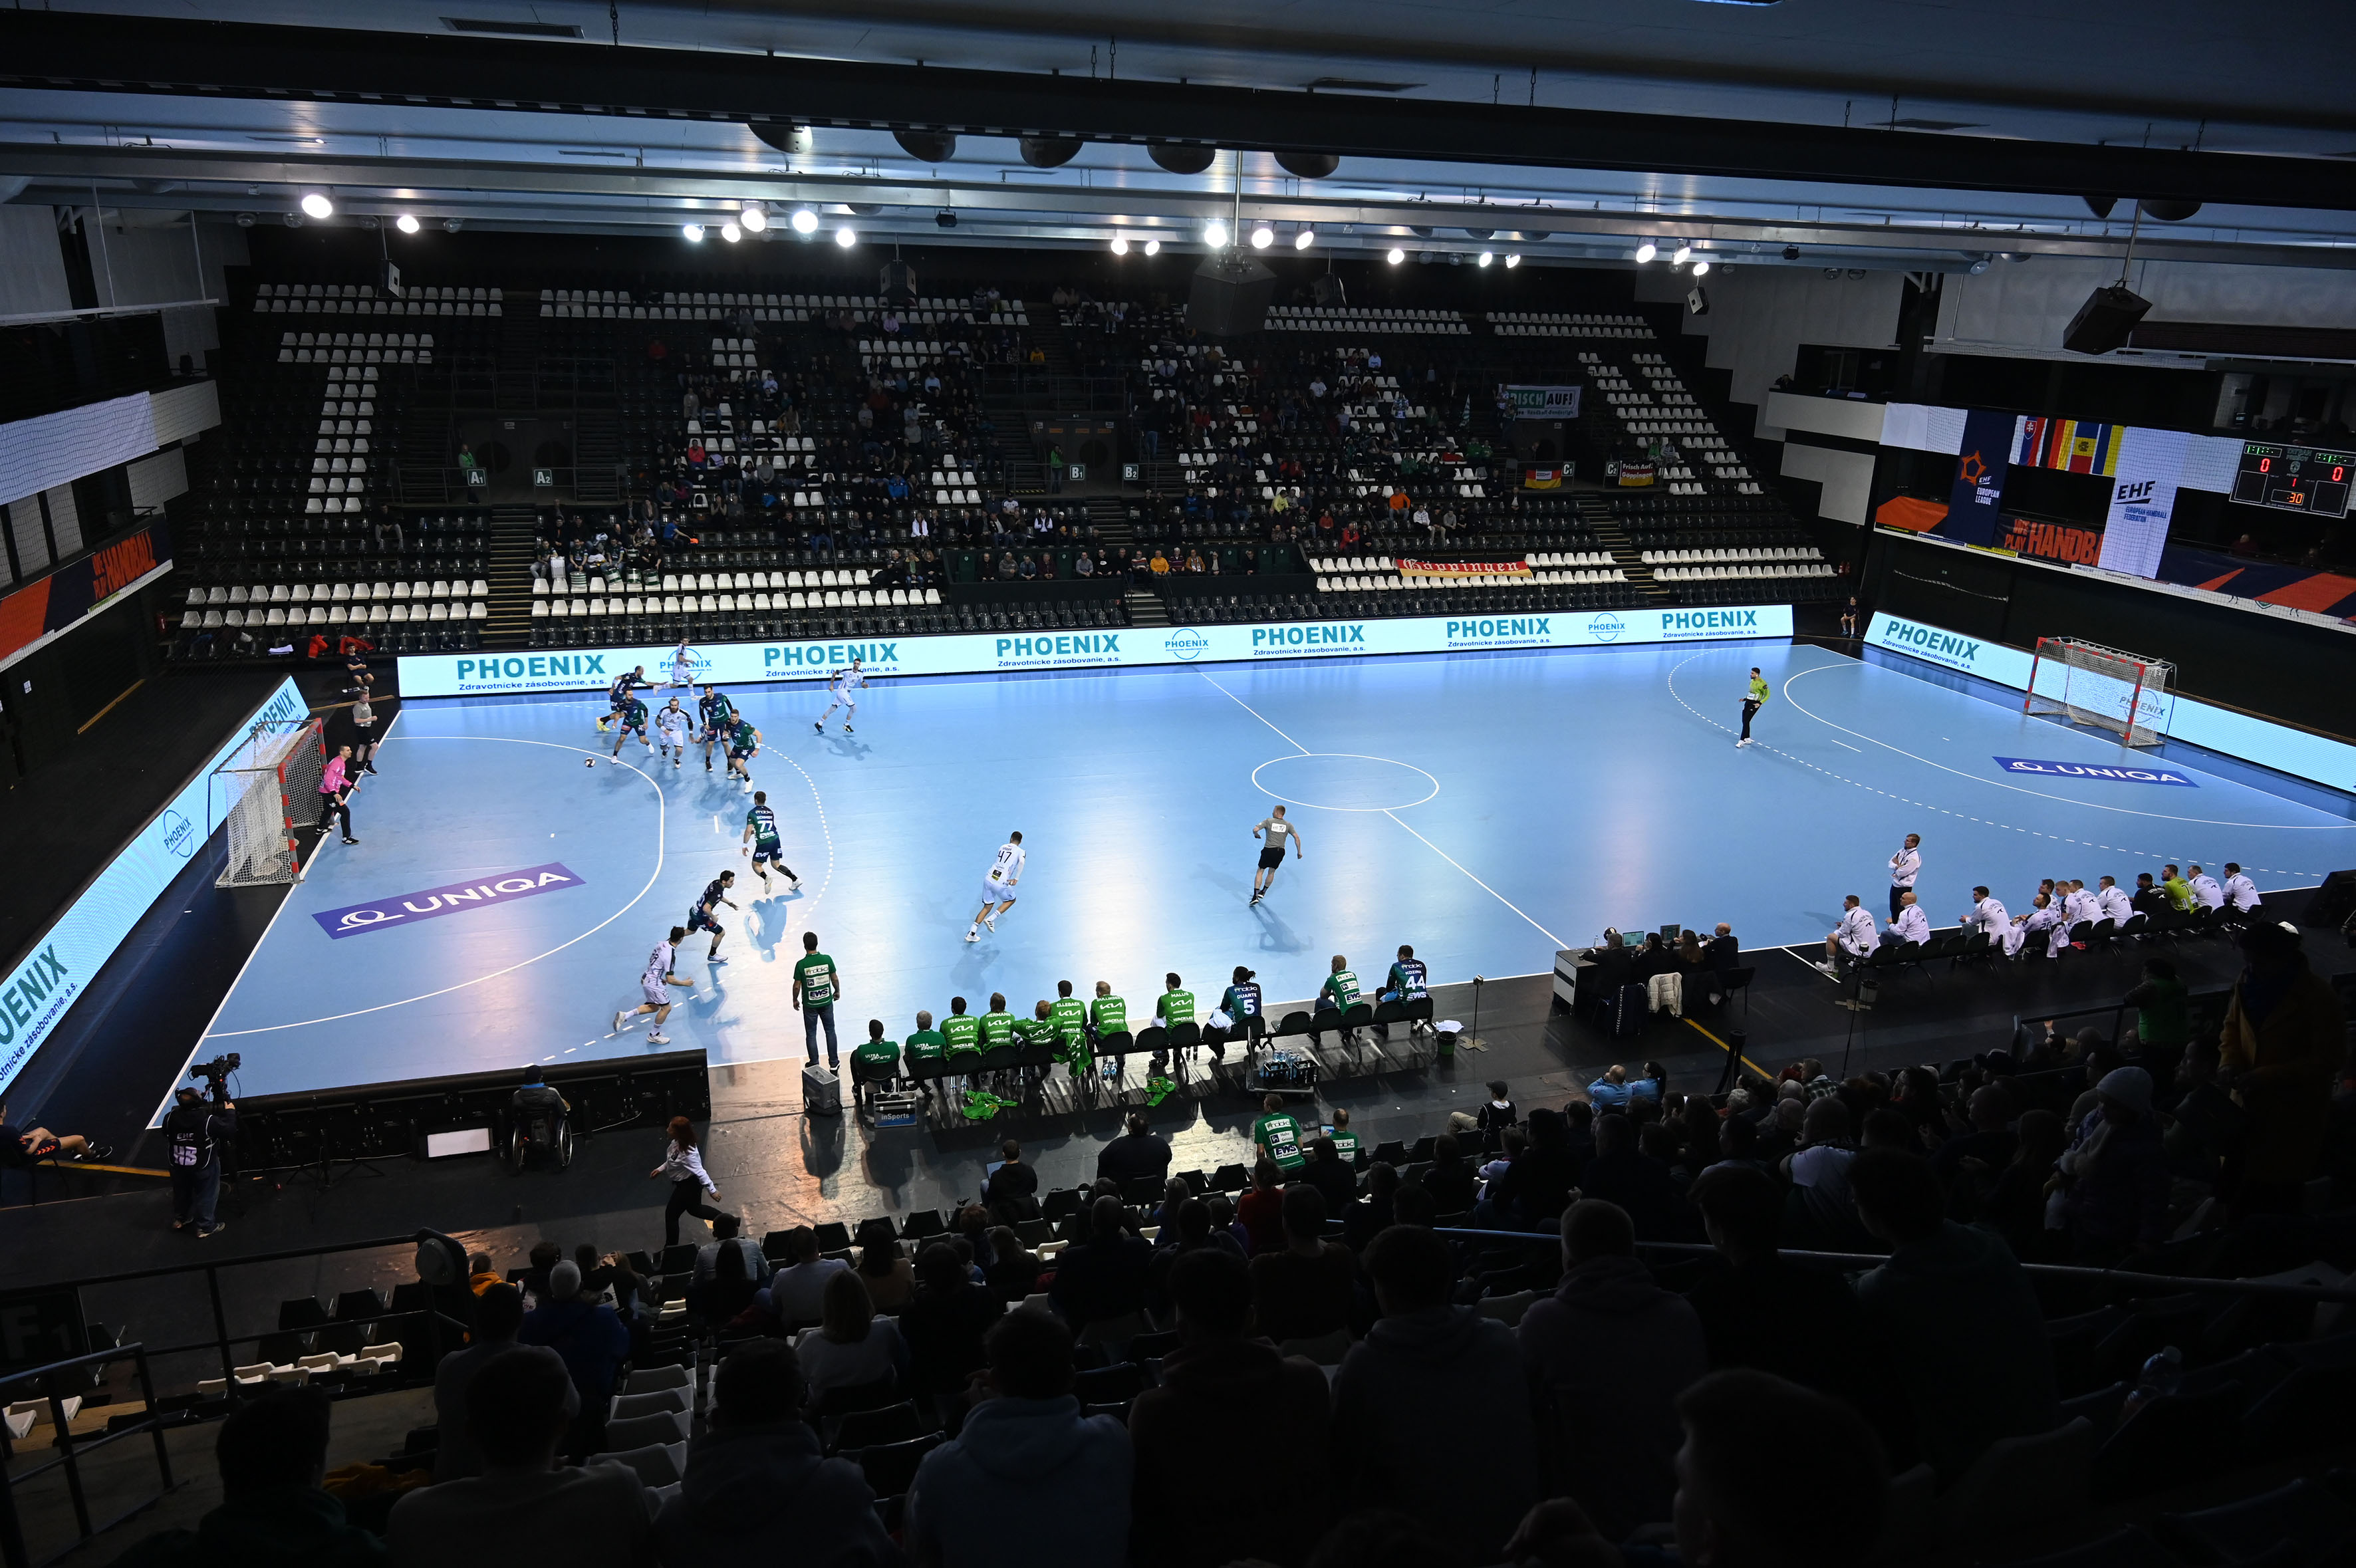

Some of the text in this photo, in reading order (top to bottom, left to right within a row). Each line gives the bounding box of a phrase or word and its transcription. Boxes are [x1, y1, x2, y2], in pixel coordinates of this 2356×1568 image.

[1510, 392, 1573, 406] RISCH AUF!
[1072, 467, 1083, 479] B1
[1125, 467, 1137, 479] B2
[1563, 462, 1573, 475] C1
[1607, 461, 1617, 475] C2
[2260, 457, 2271, 473] 0
[470, 471, 484, 484] A1
[536, 471, 551, 484] A2
[1622, 471, 1653, 479] Göppingen
[2331, 466, 2343, 482] 0
[2117, 480, 2156, 500] EHF
[2291, 478, 2297, 487] 1
[1975, 495, 1992, 505] LEAGUE
[1976, 487, 2000, 499] EUROPEAN
[2004, 533, 2027, 551] PLAY
[1402, 557, 1519, 573] Göppingen
[1446, 618, 1551, 638] PHOENIX
[1662, 610, 1758, 630] PHOENIX
[1165, 639, 1208, 648] PHOENIX
[1252, 625, 1365, 646] PHOENIX
[1885, 620, 1980, 661] PHOENIX
[996, 634, 1120, 657] PHOENIX
[764, 642, 899, 667] PHOENIX
[1920, 650, 1959, 667] zásobovanie,
[457, 654, 606, 680] PHOENIX
[2119, 696, 2166, 716] PHENIX
[2055, 765, 2188, 784] UNIQA
[164, 816, 192, 850] PHOENIX
[757, 820, 773, 833] 77
[998, 850, 1012, 864] 47
[403, 871, 571, 913] UNIQA
[1405, 975, 1425, 990] 44
[810, 988, 828, 997] EWS
[1346, 992, 1361, 1001] EWS
[1243, 999, 1255, 1015] 5
[24, 996, 68, 1049] zásobovanie,
[65, 982, 78, 997] a.s.
[1275, 1144, 1297, 1155] EWS
